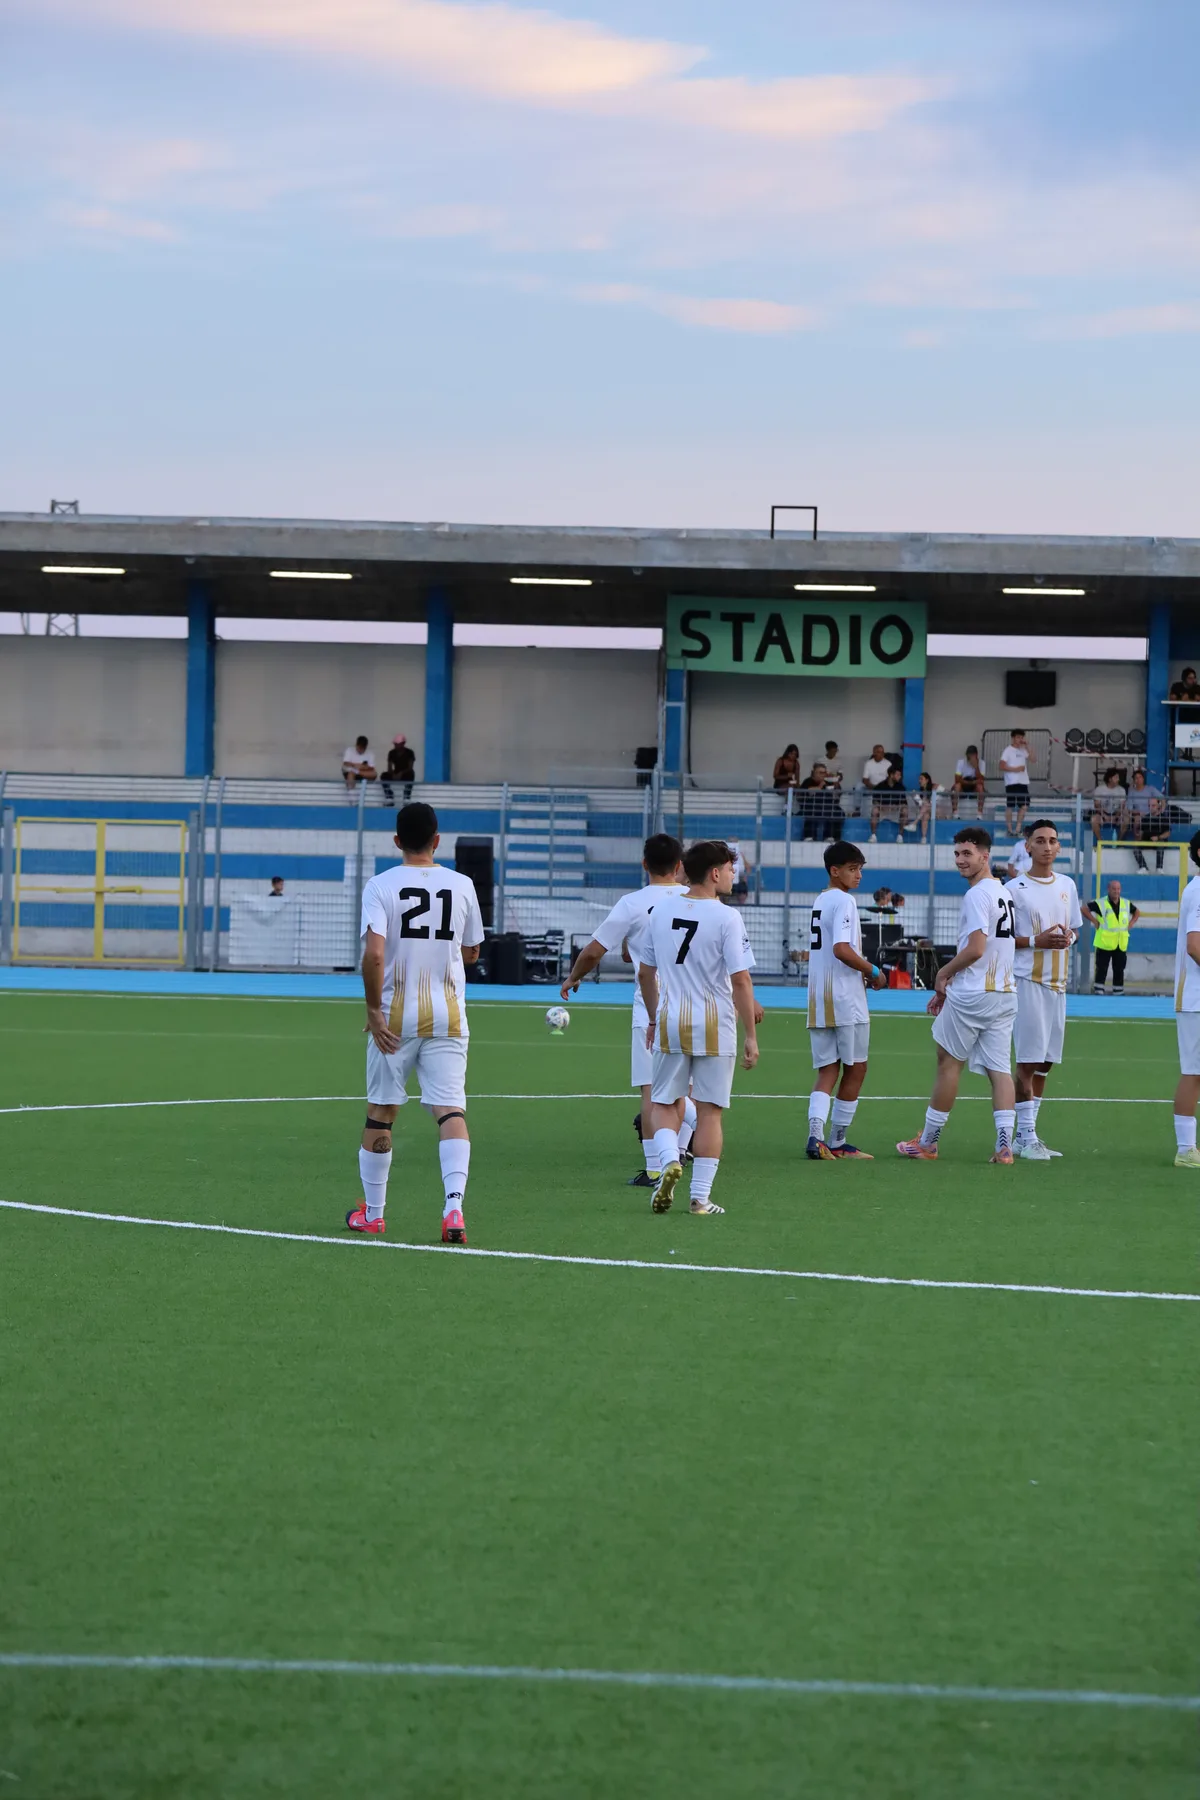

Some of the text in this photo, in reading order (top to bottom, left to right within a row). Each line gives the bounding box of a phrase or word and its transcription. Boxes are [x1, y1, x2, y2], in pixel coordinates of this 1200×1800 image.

[680, 609, 914, 666] STADIO
[398, 887, 455, 941] 21
[810, 909, 823, 951] 5
[671, 917, 699, 965] 7
